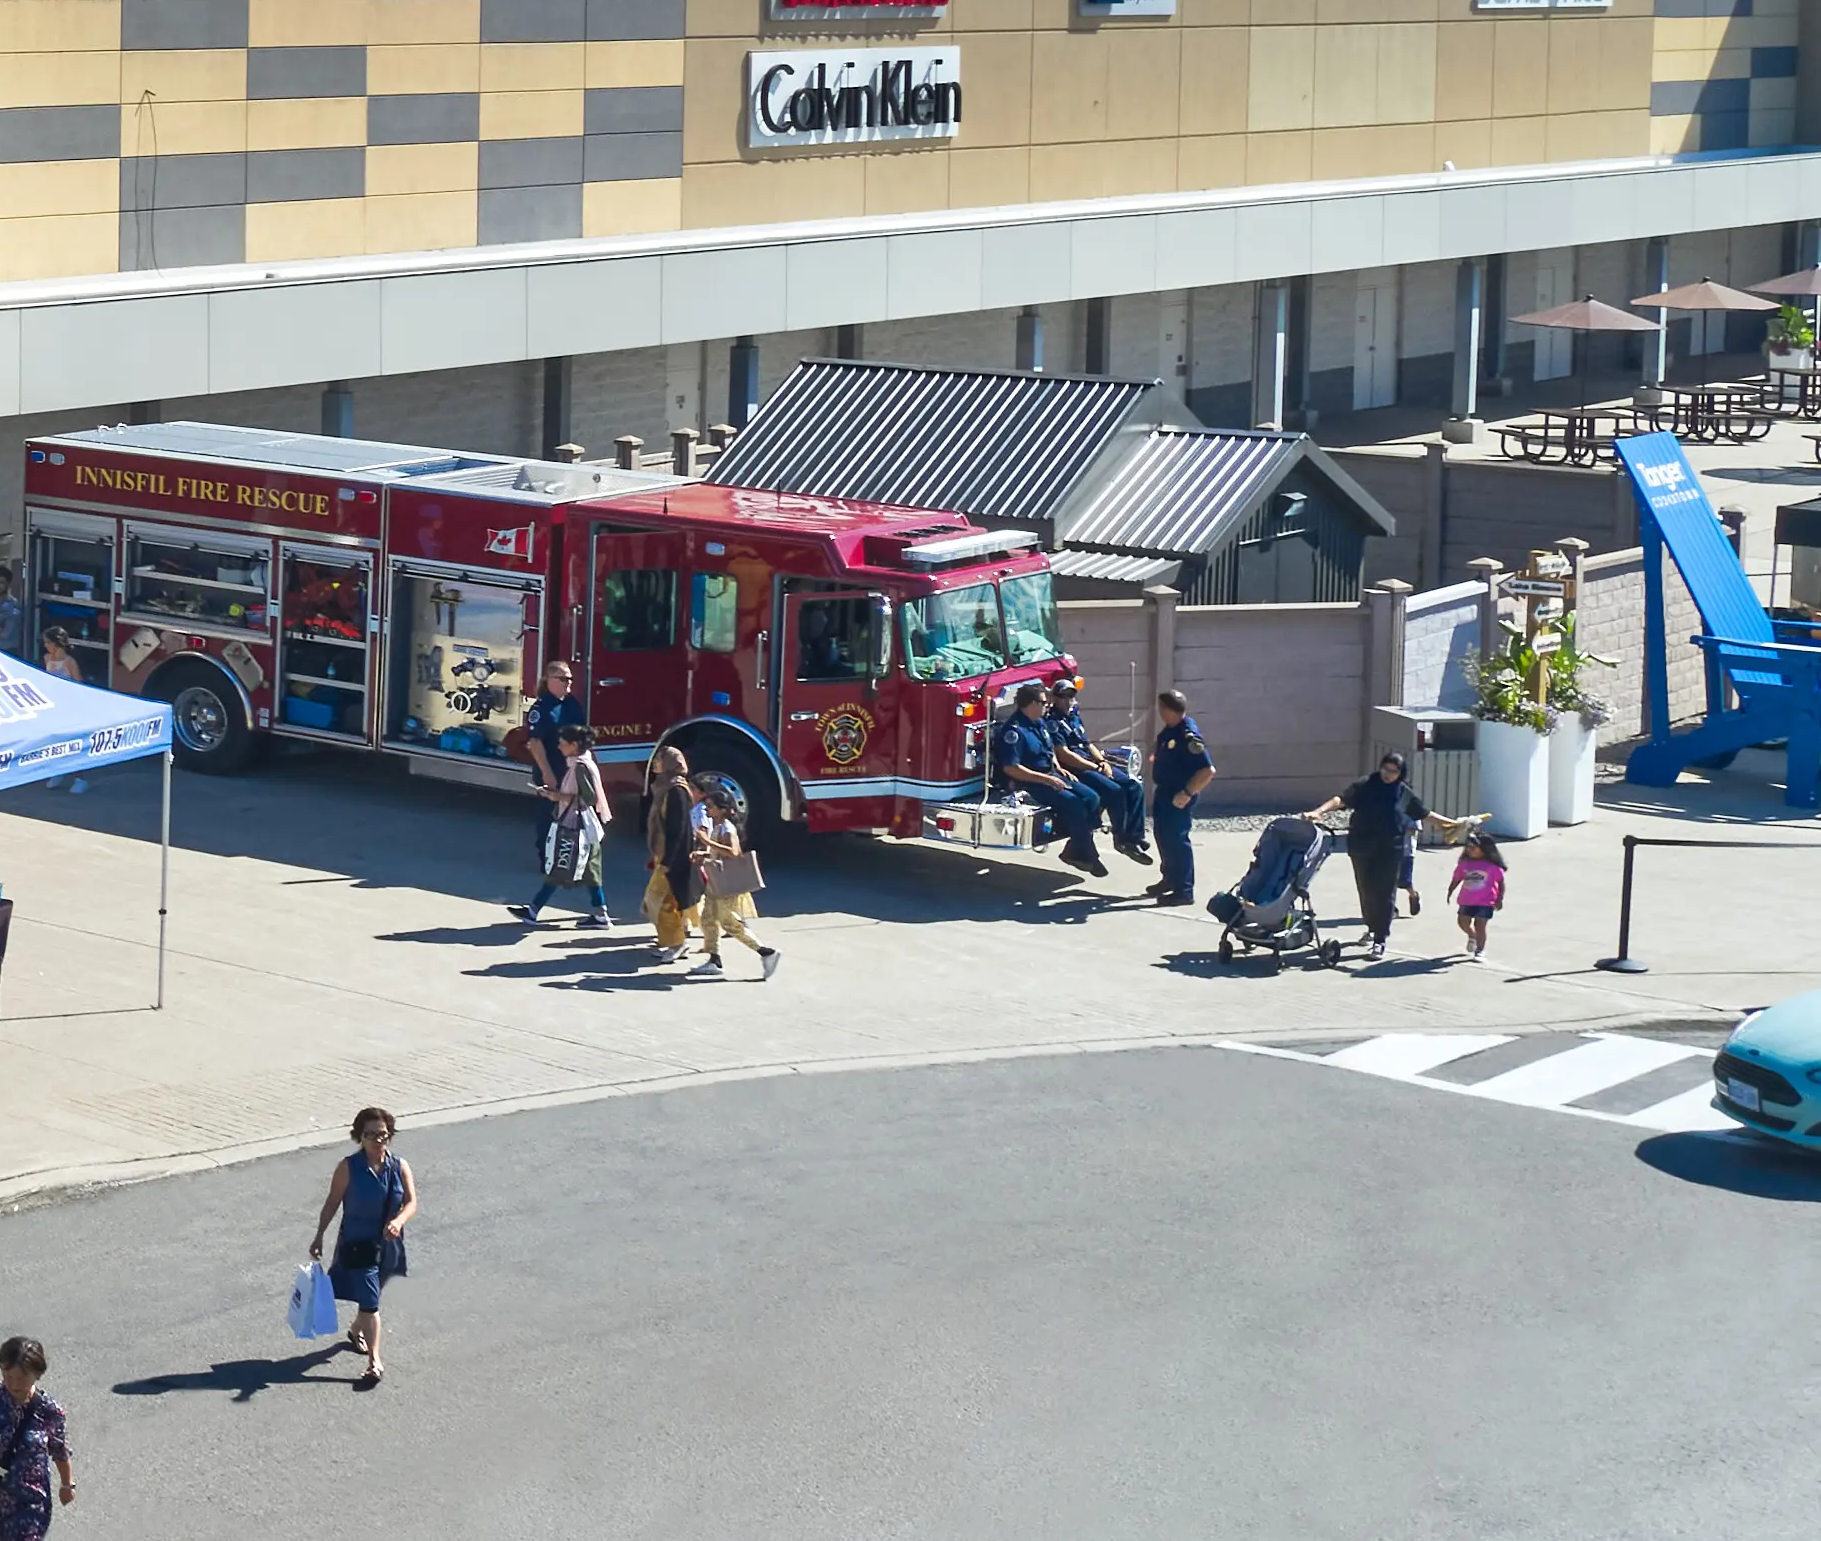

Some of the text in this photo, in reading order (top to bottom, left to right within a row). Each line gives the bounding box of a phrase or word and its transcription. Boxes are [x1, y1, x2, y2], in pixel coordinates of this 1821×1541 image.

[760, 59, 962, 133] Calvin Klein
[75, 465, 329, 516] INNISFIL FIRE RESCUE
[644, 723, 653, 735] 2
[557, 839, 574, 868] DSW
